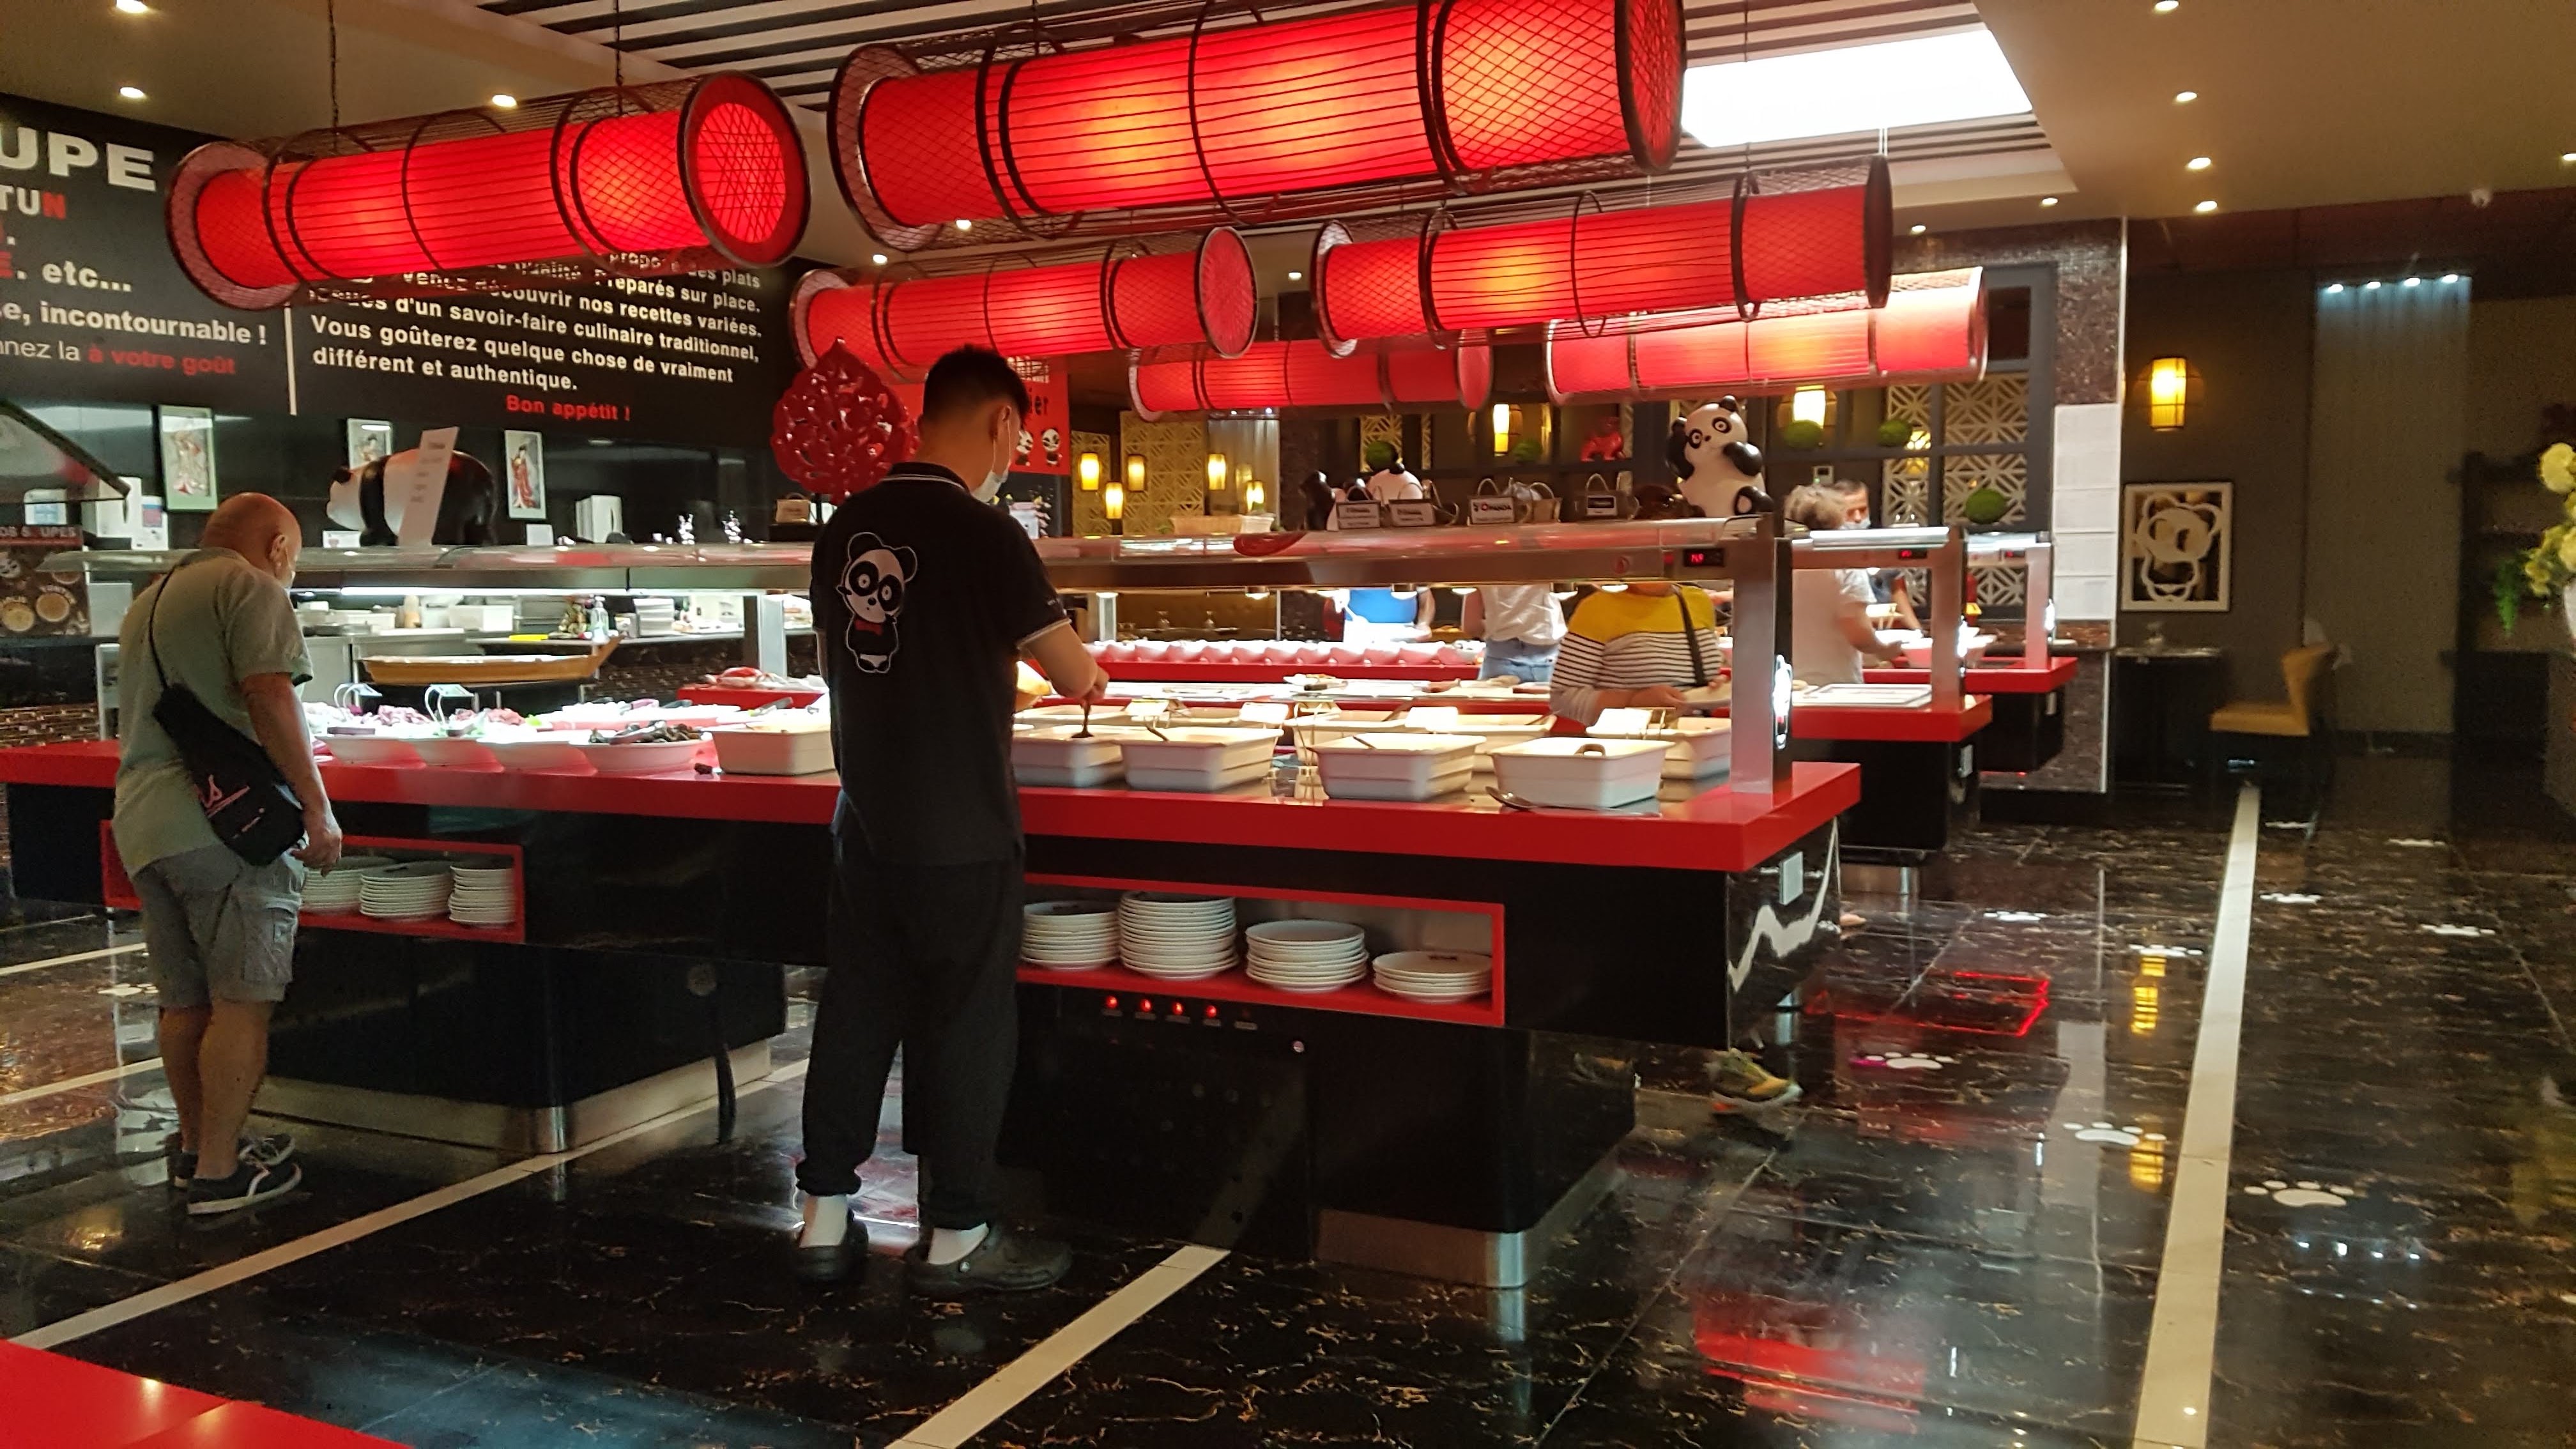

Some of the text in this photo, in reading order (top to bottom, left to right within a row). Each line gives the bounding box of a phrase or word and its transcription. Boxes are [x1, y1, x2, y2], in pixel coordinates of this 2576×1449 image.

[0, 126, 157, 192] UPE
[42, 260, 132, 292] etc...
[722, 269, 760, 288] plats
[579, 296, 613, 314] nos
[620, 303, 692, 326] recettes
[698, 315, 762, 337] variées.
[680, 288, 707, 303] sur
[714, 292, 760, 313] place.
[40, 300, 251, 344] incontournable
[395, 298, 441, 317] d'un
[450, 305, 567, 334] savoir-faire
[574, 321, 654, 346] culinaire
[659, 332, 759, 363] traditionnel,
[59, 341, 80, 361] la
[111, 350, 174, 367] votre
[311, 314, 733, 383] Vous goûterez quelque chose de vraiment
[312, 347, 577, 391] différent et authentique.
[507, 395, 544, 414] Bon
[553, 402, 618, 420] appétit
